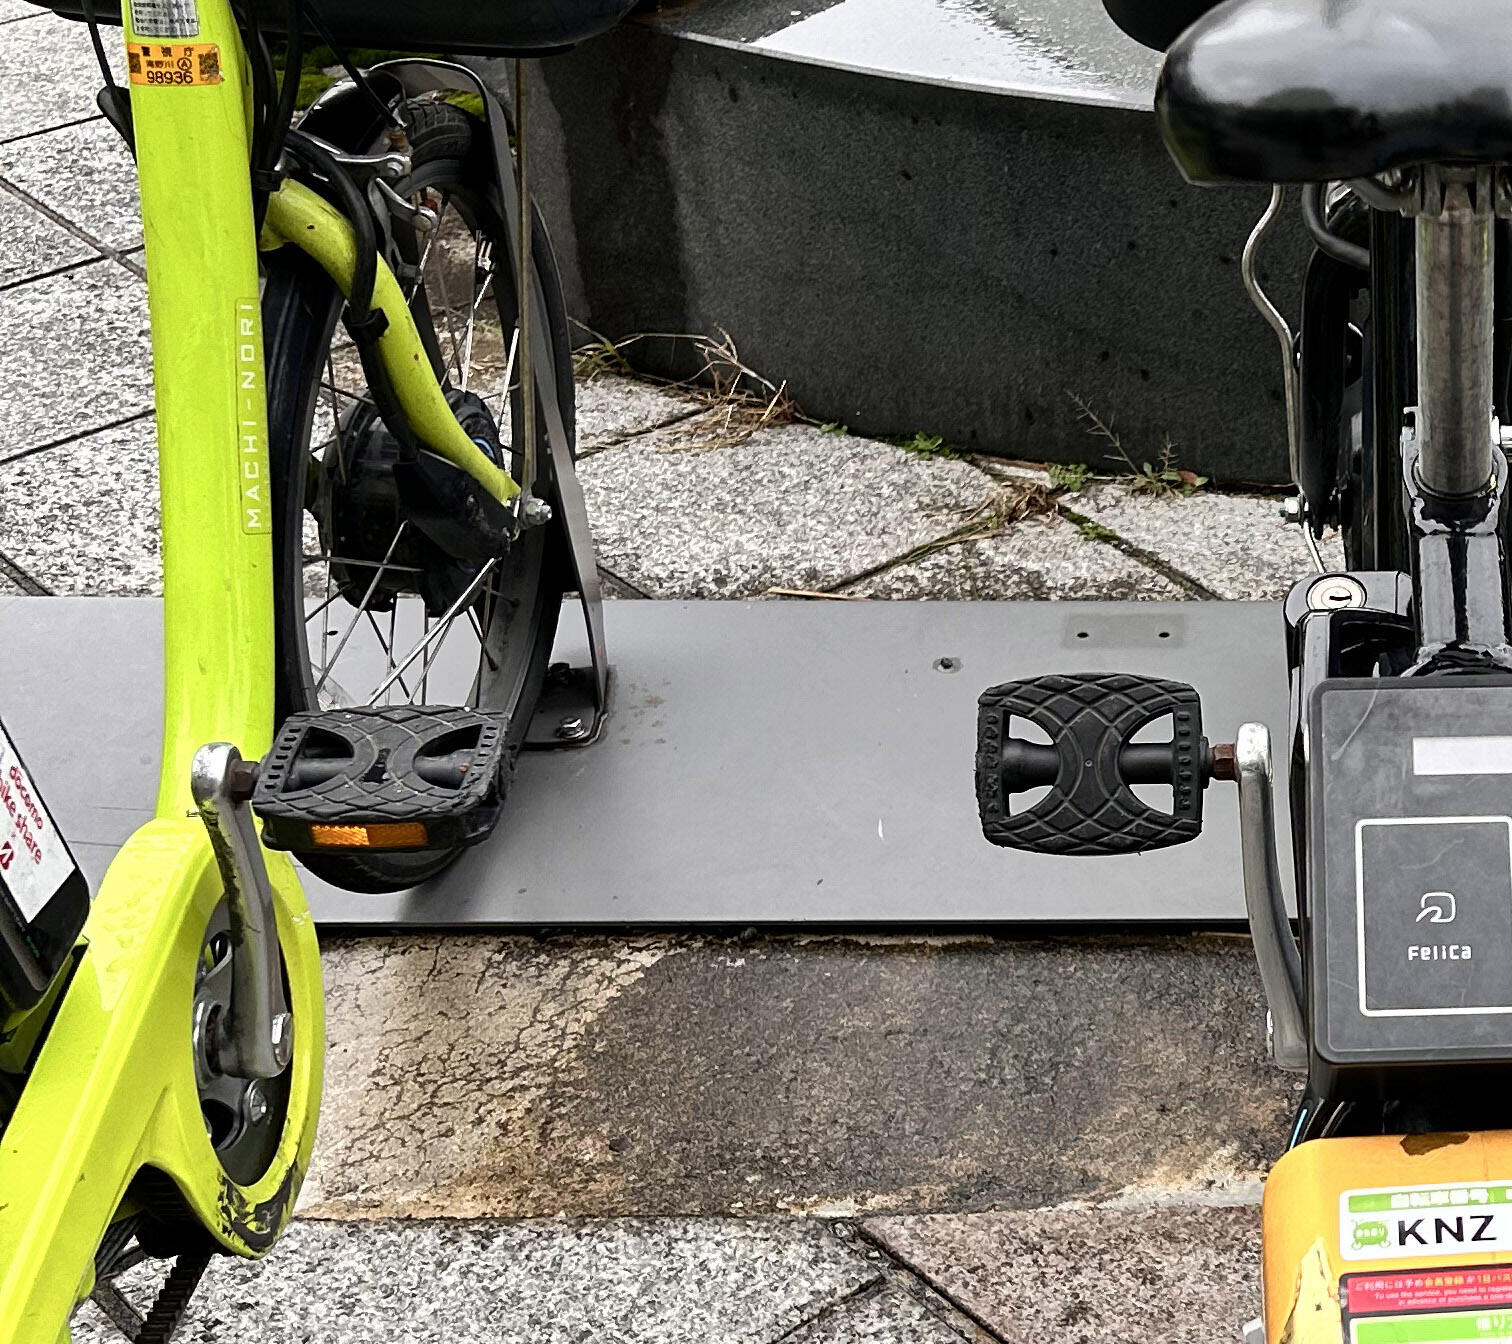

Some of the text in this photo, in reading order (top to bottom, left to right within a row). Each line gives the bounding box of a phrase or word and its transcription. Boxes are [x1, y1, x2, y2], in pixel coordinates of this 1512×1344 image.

[146, 71, 194, 84] 98936
[240, 303, 262, 528] MACHI-NORI
[10, 765, 43, 830] docomo
[16, 813, 42, 864] share
[1397, 1215, 1498, 1247] KNZ
